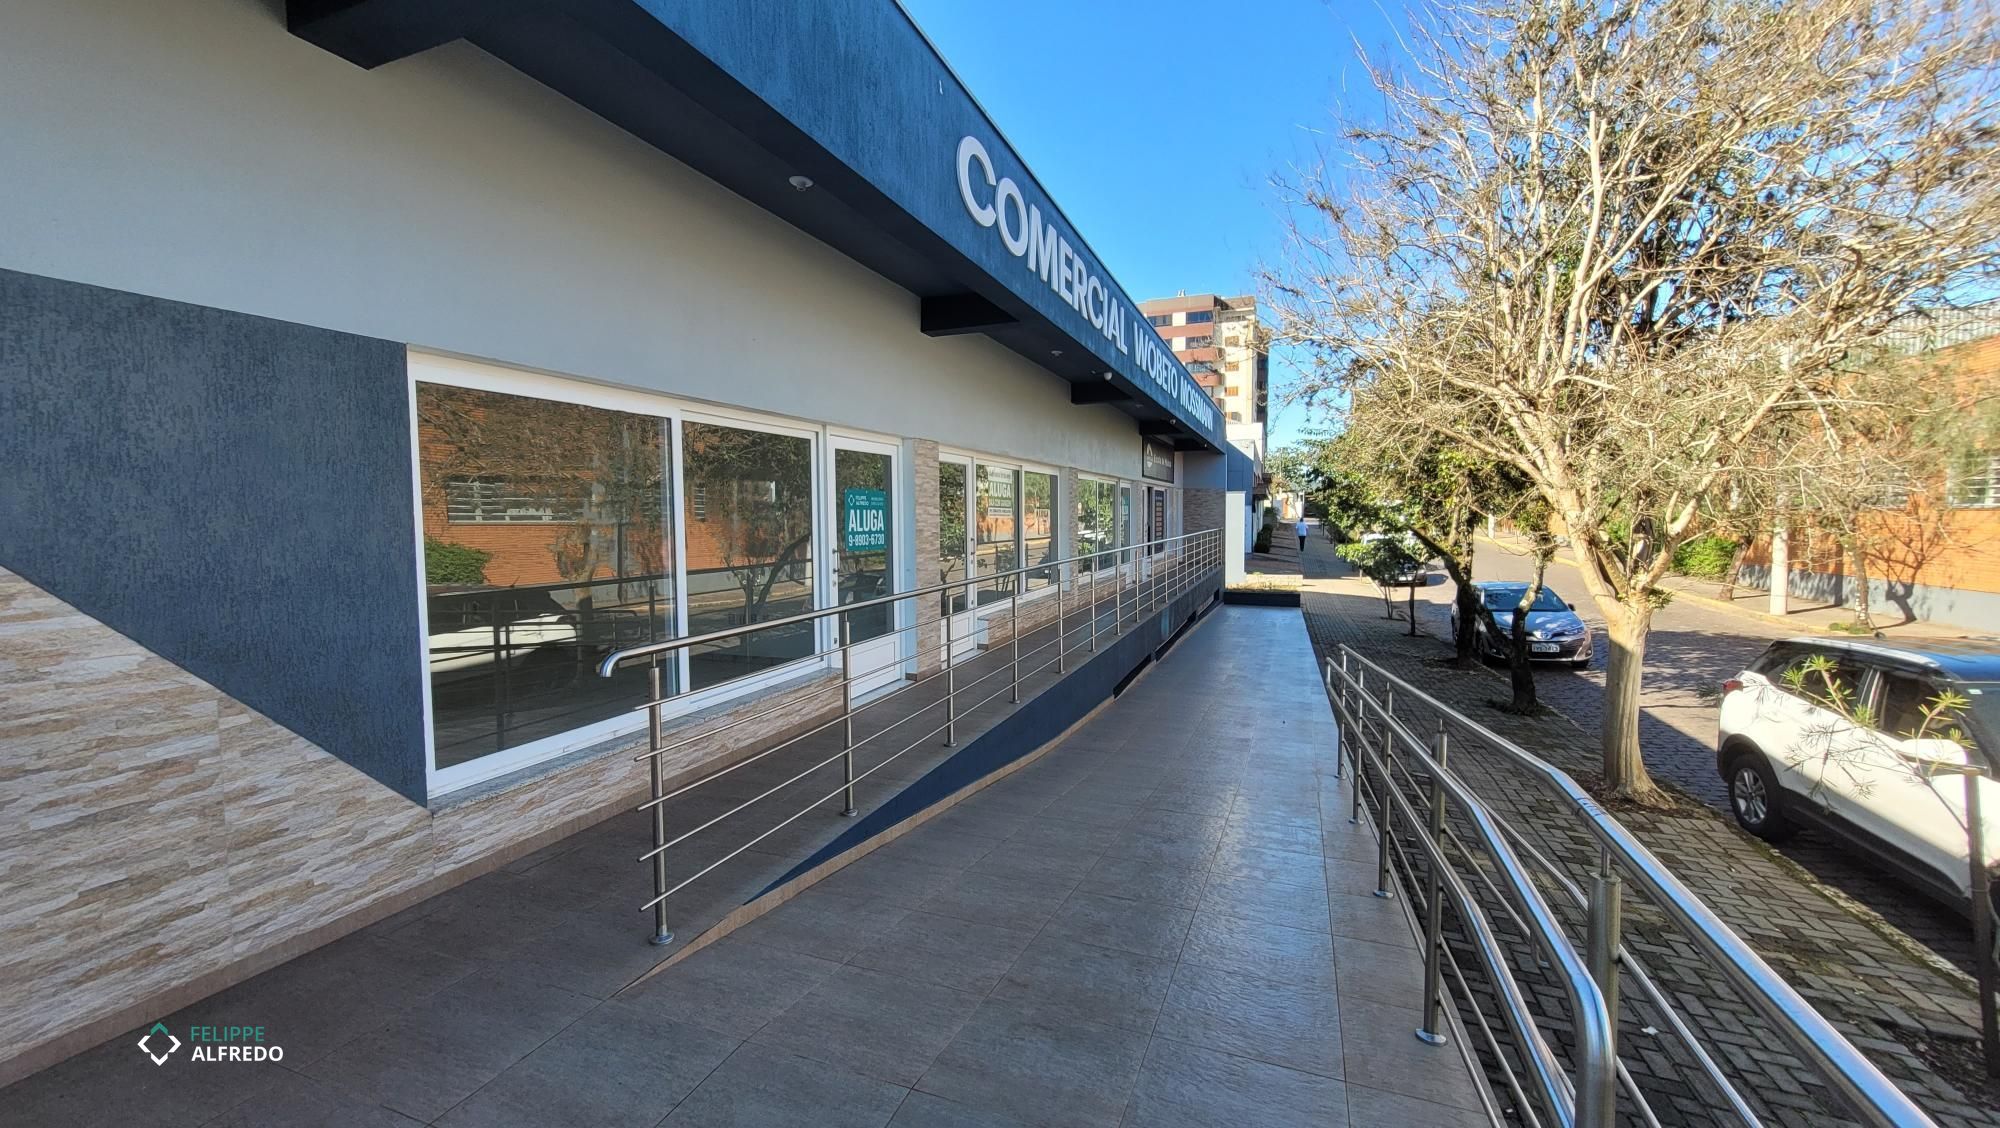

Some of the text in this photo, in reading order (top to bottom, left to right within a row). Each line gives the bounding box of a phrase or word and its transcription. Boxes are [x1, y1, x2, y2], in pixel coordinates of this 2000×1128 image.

[956, 135, 1214, 433] COMERCIAL WOBETO MOSSMANN
[989, 481, 1012, 499] ALUGA
[848, 508, 885, 532] ALUGA
[848, 533, 885, 547] 9-8903-6730
